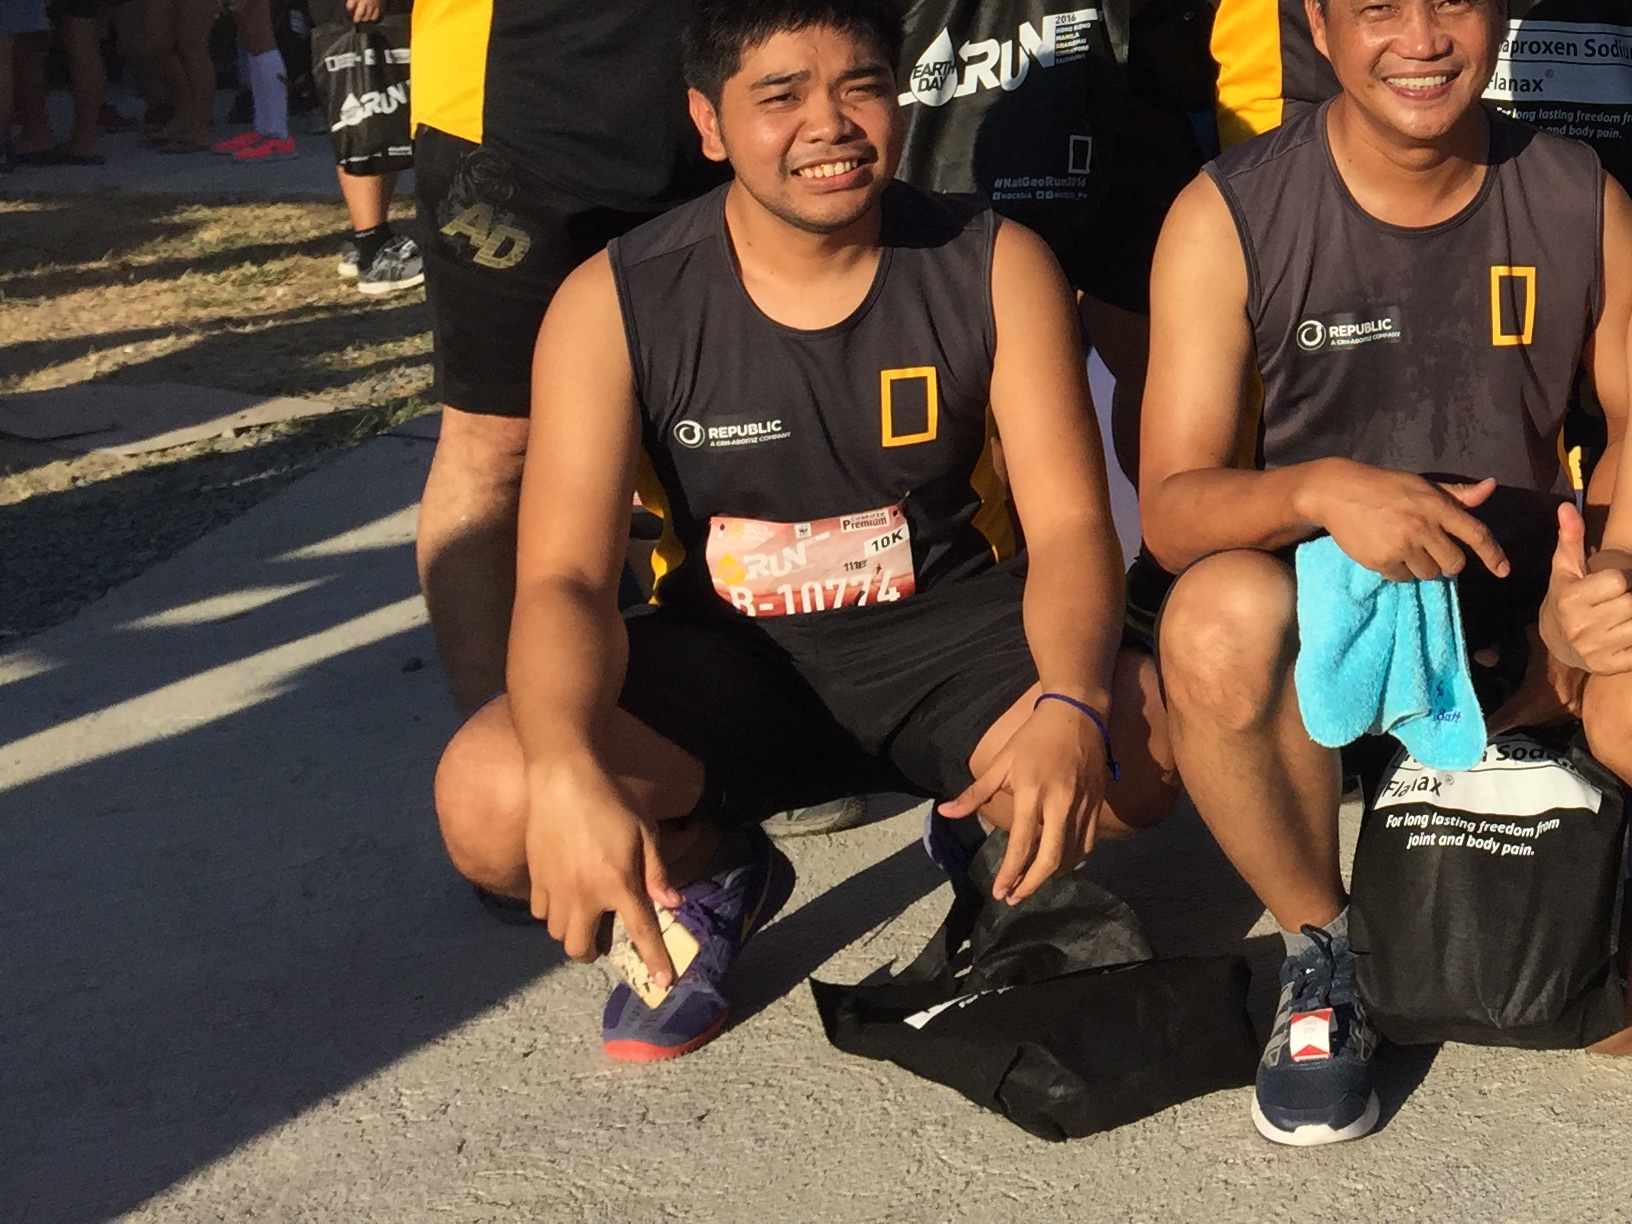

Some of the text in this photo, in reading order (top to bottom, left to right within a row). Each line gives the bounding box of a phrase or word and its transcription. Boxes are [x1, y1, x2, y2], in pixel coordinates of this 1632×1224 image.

[1055, 14, 1077, 24] 2016
[954, 16, 1057, 98] RUN
[1498, 38, 1578, 58] aproxen
[913, 60, 958, 79] EARTH
[917, 77, 948, 93] DAY
[1486, 72, 1545, 92] lanax
[1512, 108, 1537, 122] long
[1538, 108, 1574, 123] lasting
[1575, 109, 1621, 124] freedom
[1568, 124, 1595, 138] body
[1596, 126, 1623, 139] pain.
[1329, 318, 1392, 338] REPUBLIC
[708, 419, 782, 439] REPUBLIC
[843, 517, 887, 531] Premium
[871, 528, 904, 552] 10K
[742, 542, 807, 580] RUN
[1386, 812, 1560, 839] For long lasting freedom from
[1406, 832, 1535, 857] joint and body pain.
